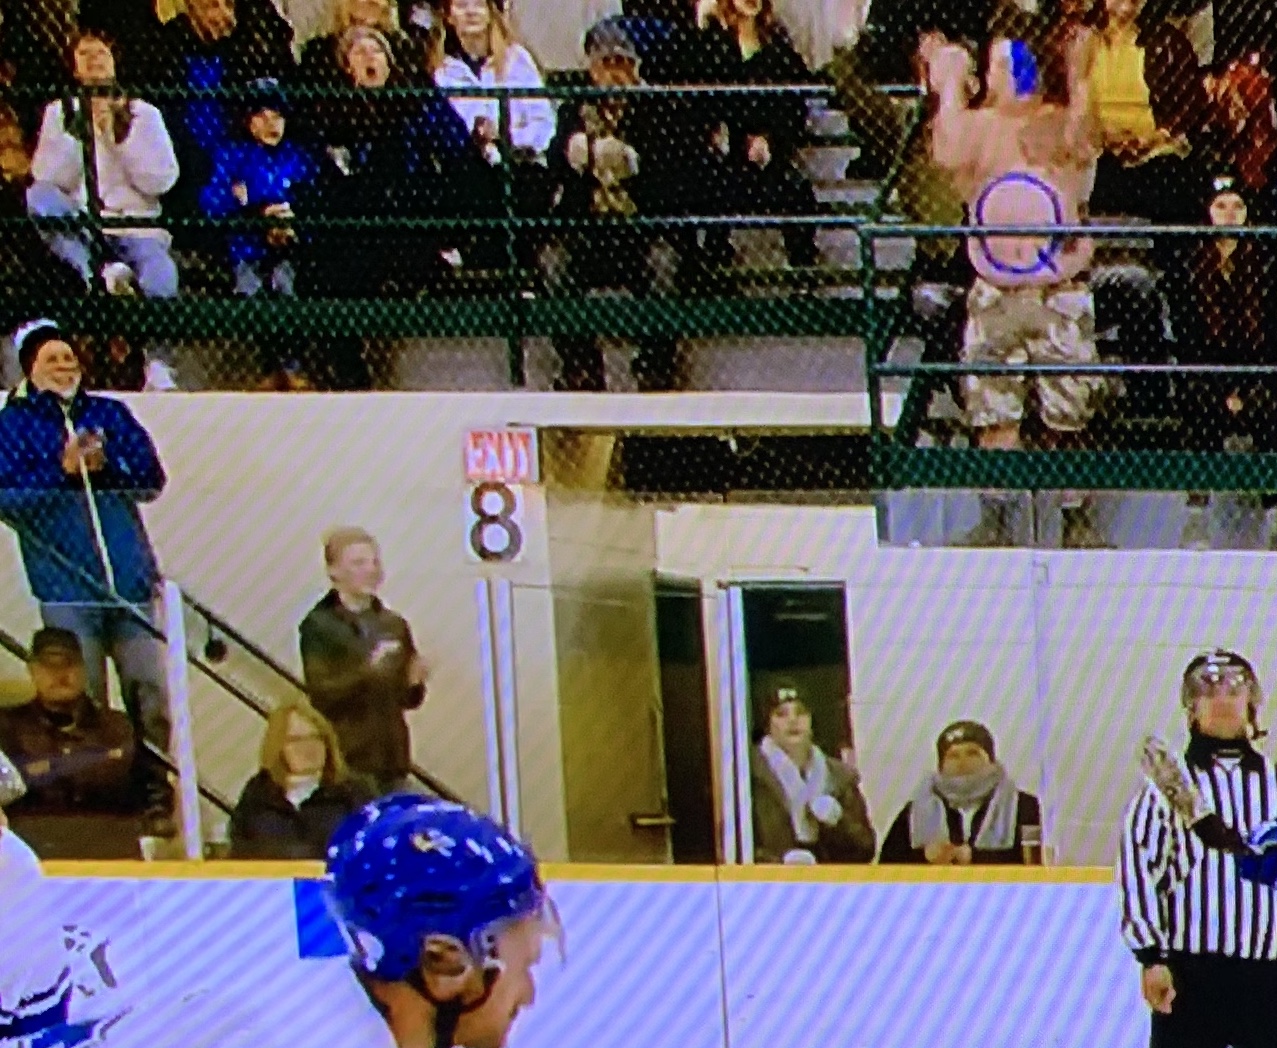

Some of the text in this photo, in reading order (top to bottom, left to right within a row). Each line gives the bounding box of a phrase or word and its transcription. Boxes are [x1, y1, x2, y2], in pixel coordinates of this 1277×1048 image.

[976, 171, 1062, 274] Q
[465, 431, 538, 480] EXIT
[470, 482, 523, 562] 8
